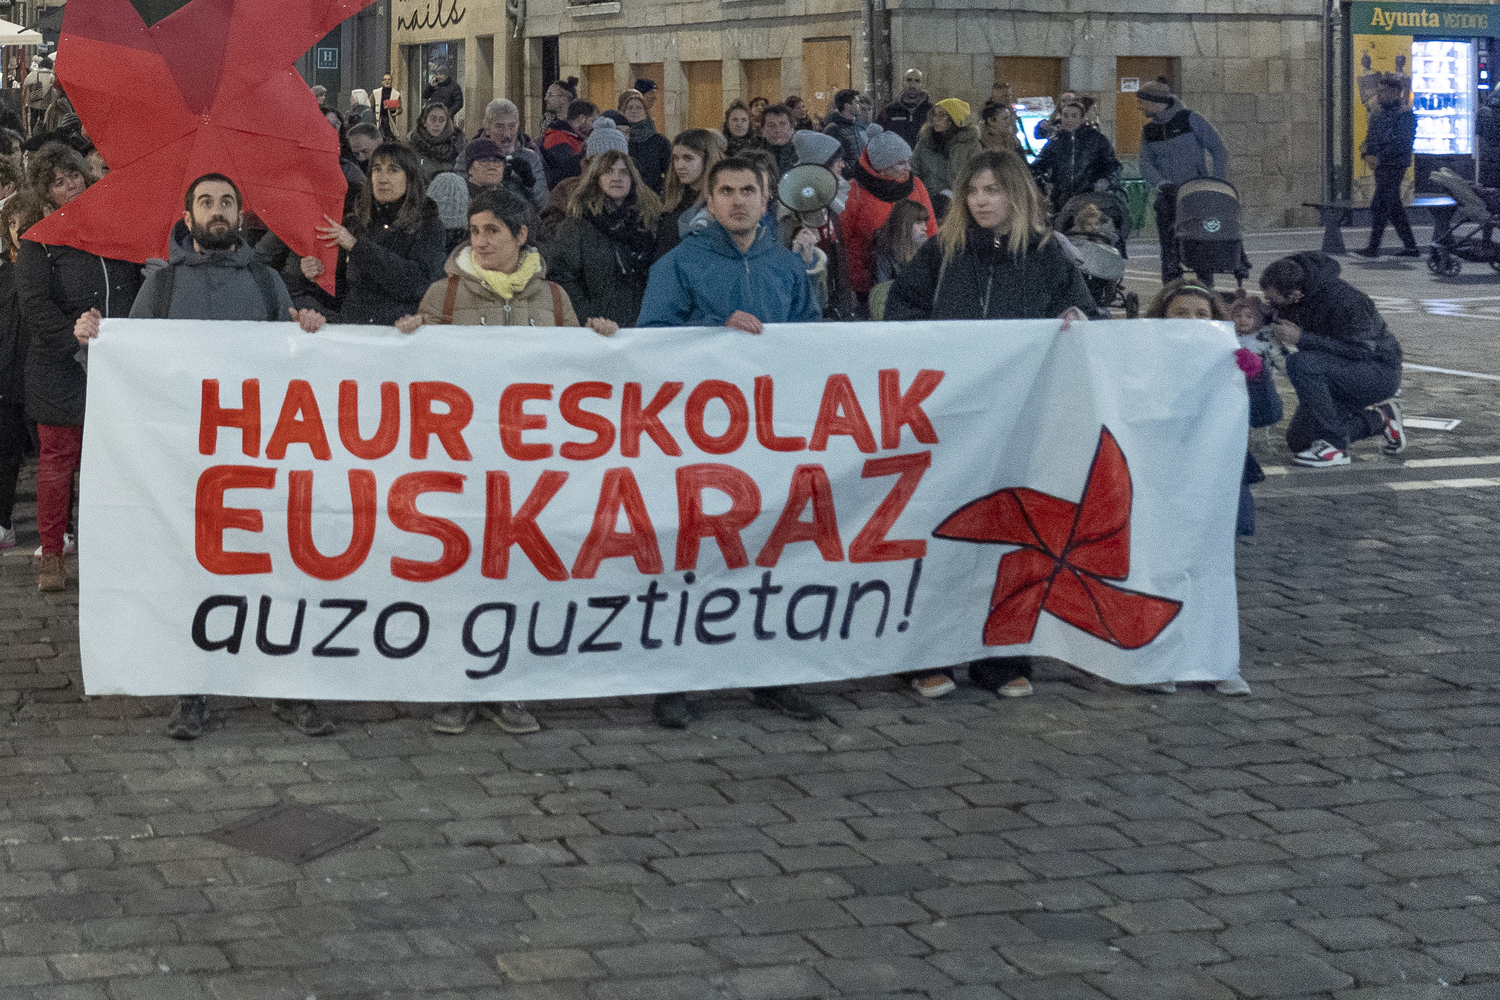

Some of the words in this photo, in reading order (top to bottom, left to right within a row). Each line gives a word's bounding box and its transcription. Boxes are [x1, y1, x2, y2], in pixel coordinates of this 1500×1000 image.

[323, 50, 332, 62] H
[1370, 7, 1441, 31] Ayunta
[198, 378, 474, 461] HAUR
[498, 368, 946, 461] ESKOLAK
[194, 450, 933, 583] EUSKARAZ
[191, 594, 431, 659] auzo
[461, 557, 924, 678] guztietan!
